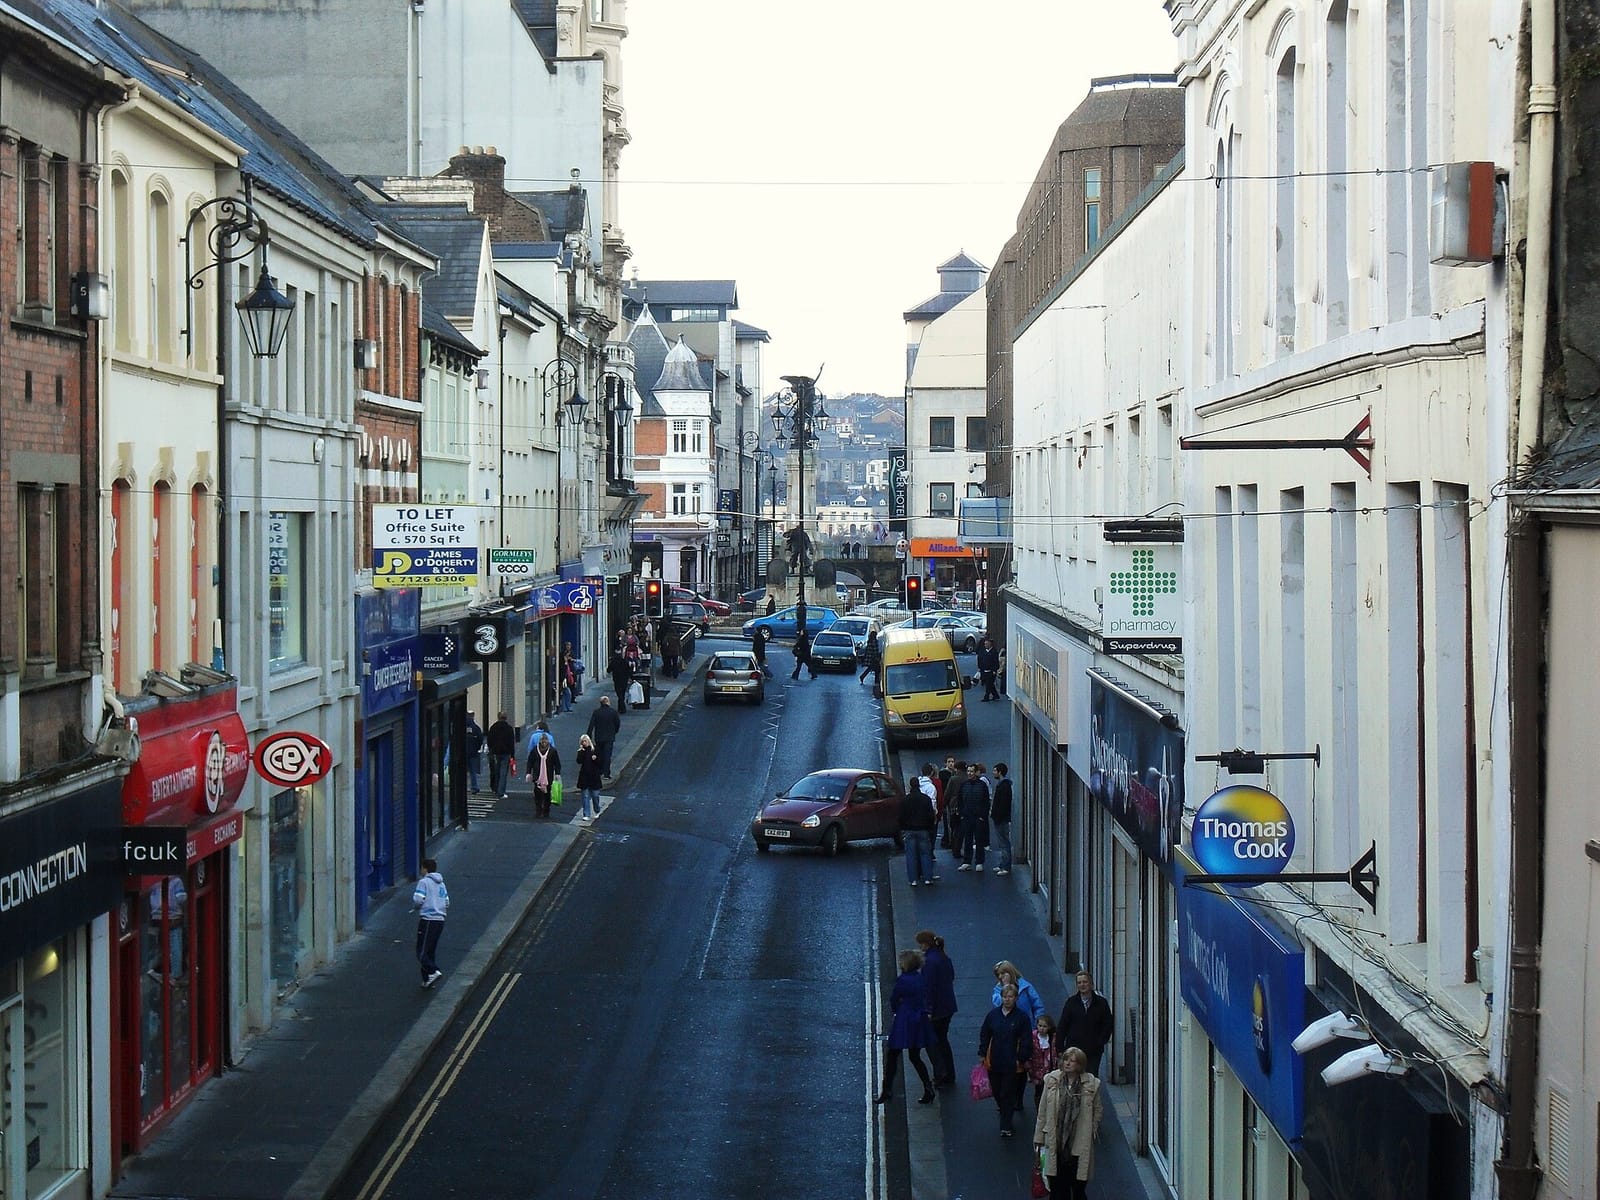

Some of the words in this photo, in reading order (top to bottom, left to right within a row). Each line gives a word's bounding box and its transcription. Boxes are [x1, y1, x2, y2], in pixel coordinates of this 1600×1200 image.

[81, 287, 87, 296] 5
[896, 455, 905, 487] TOWER
[896, 490, 905, 516] HOTEL
[396, 508, 418, 520] TO
[425, 508, 454, 520] LET
[385, 523, 426, 533] Office
[430, 523, 465, 533] Suite
[390, 536, 400, 544] c.
[404, 535, 426, 544] 570
[430, 535, 445, 546] Sq
[448, 535, 461, 544] Ft
[928, 543, 964, 553] Alliance
[414, 558, 475, 567] O'DOHERTY
[428, 550, 462, 558] JAMES
[497, 564, 528, 573] ecco
[1110, 619, 1176, 633] pharmacy
[474, 624, 499, 655] 3
[1109, 640, 1177, 651] Superdrug
[152, 765, 197, 803] ENTERTAINMENT
[214, 820, 237, 845] EXCHANGE
[1199, 818, 1288, 838] Thomas
[123, 841, 178, 861] fcuk
[1233, 838, 1288, 858] Cook
[0, 841, 87, 913] CONNECTION
[1186, 911, 1211, 985] Thomas
[1211, 940, 1231, 1007] Cook
